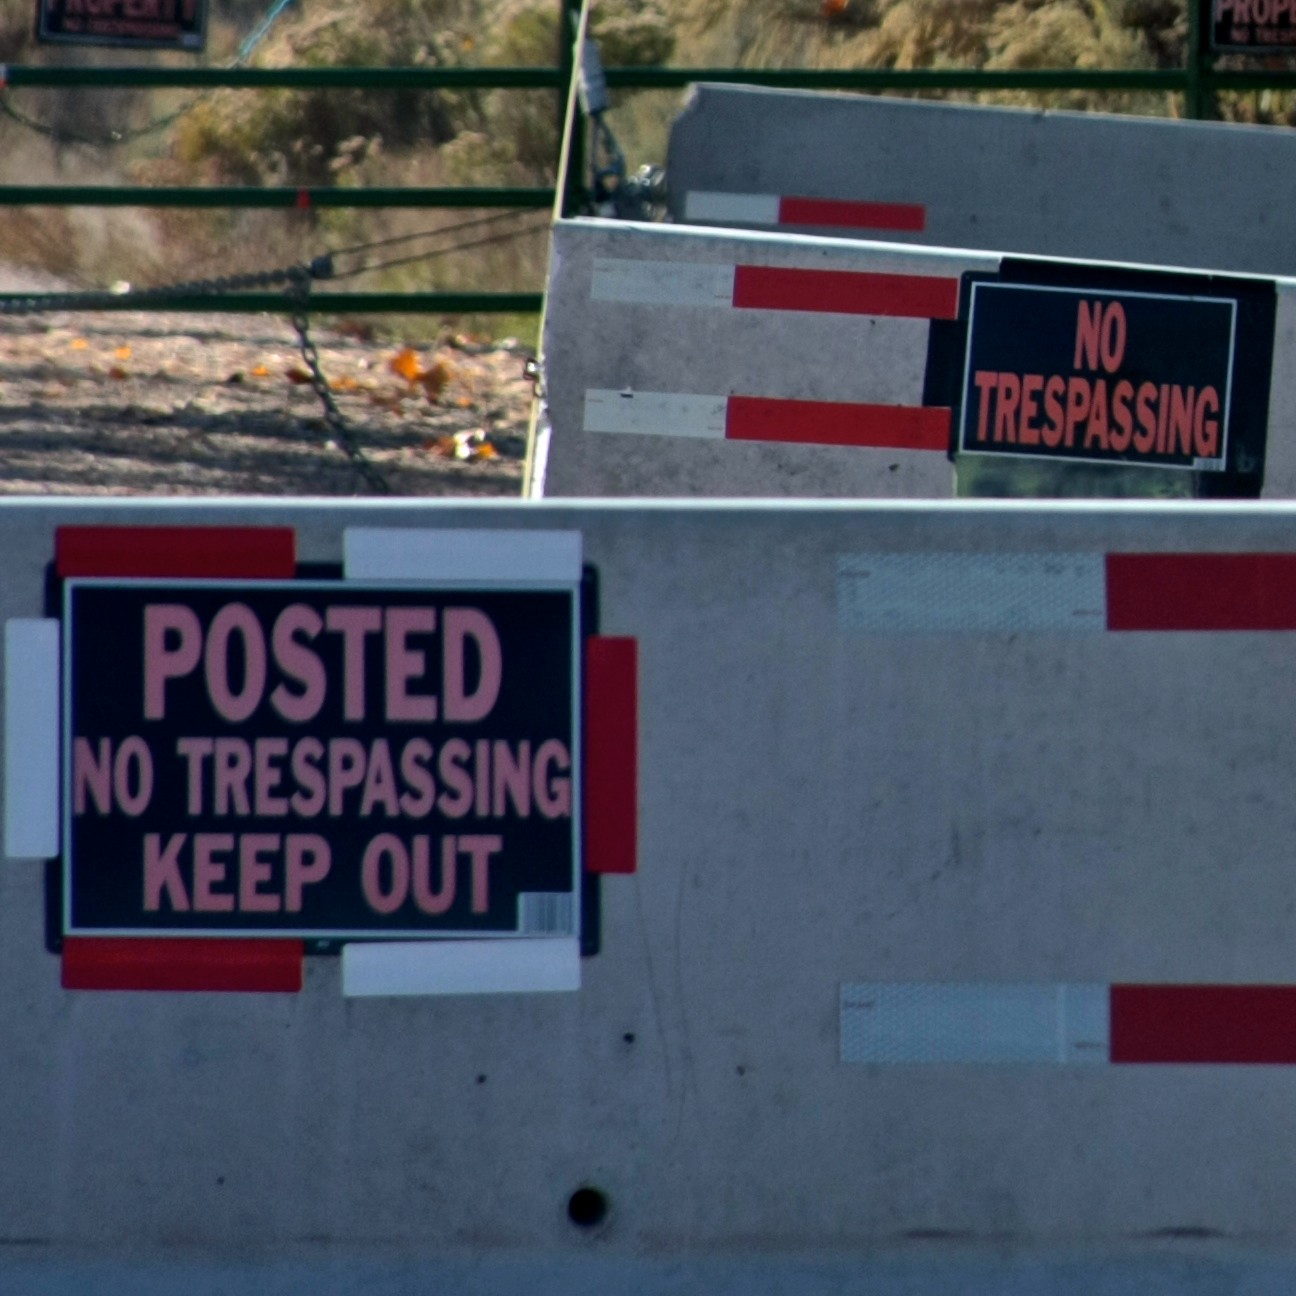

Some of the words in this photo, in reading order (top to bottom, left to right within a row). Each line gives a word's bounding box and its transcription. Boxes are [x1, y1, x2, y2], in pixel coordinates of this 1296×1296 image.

[1073, 299, 1127, 373] NO
[975, 370, 1220, 456] TRESPASSING
[143, 602, 501, 723] POSTED
[73, 736, 153, 816] NO
[177, 737, 571, 818] TRESPASSING
[143, 833, 331, 912] KEEP
[361, 832, 502, 914] OUT
